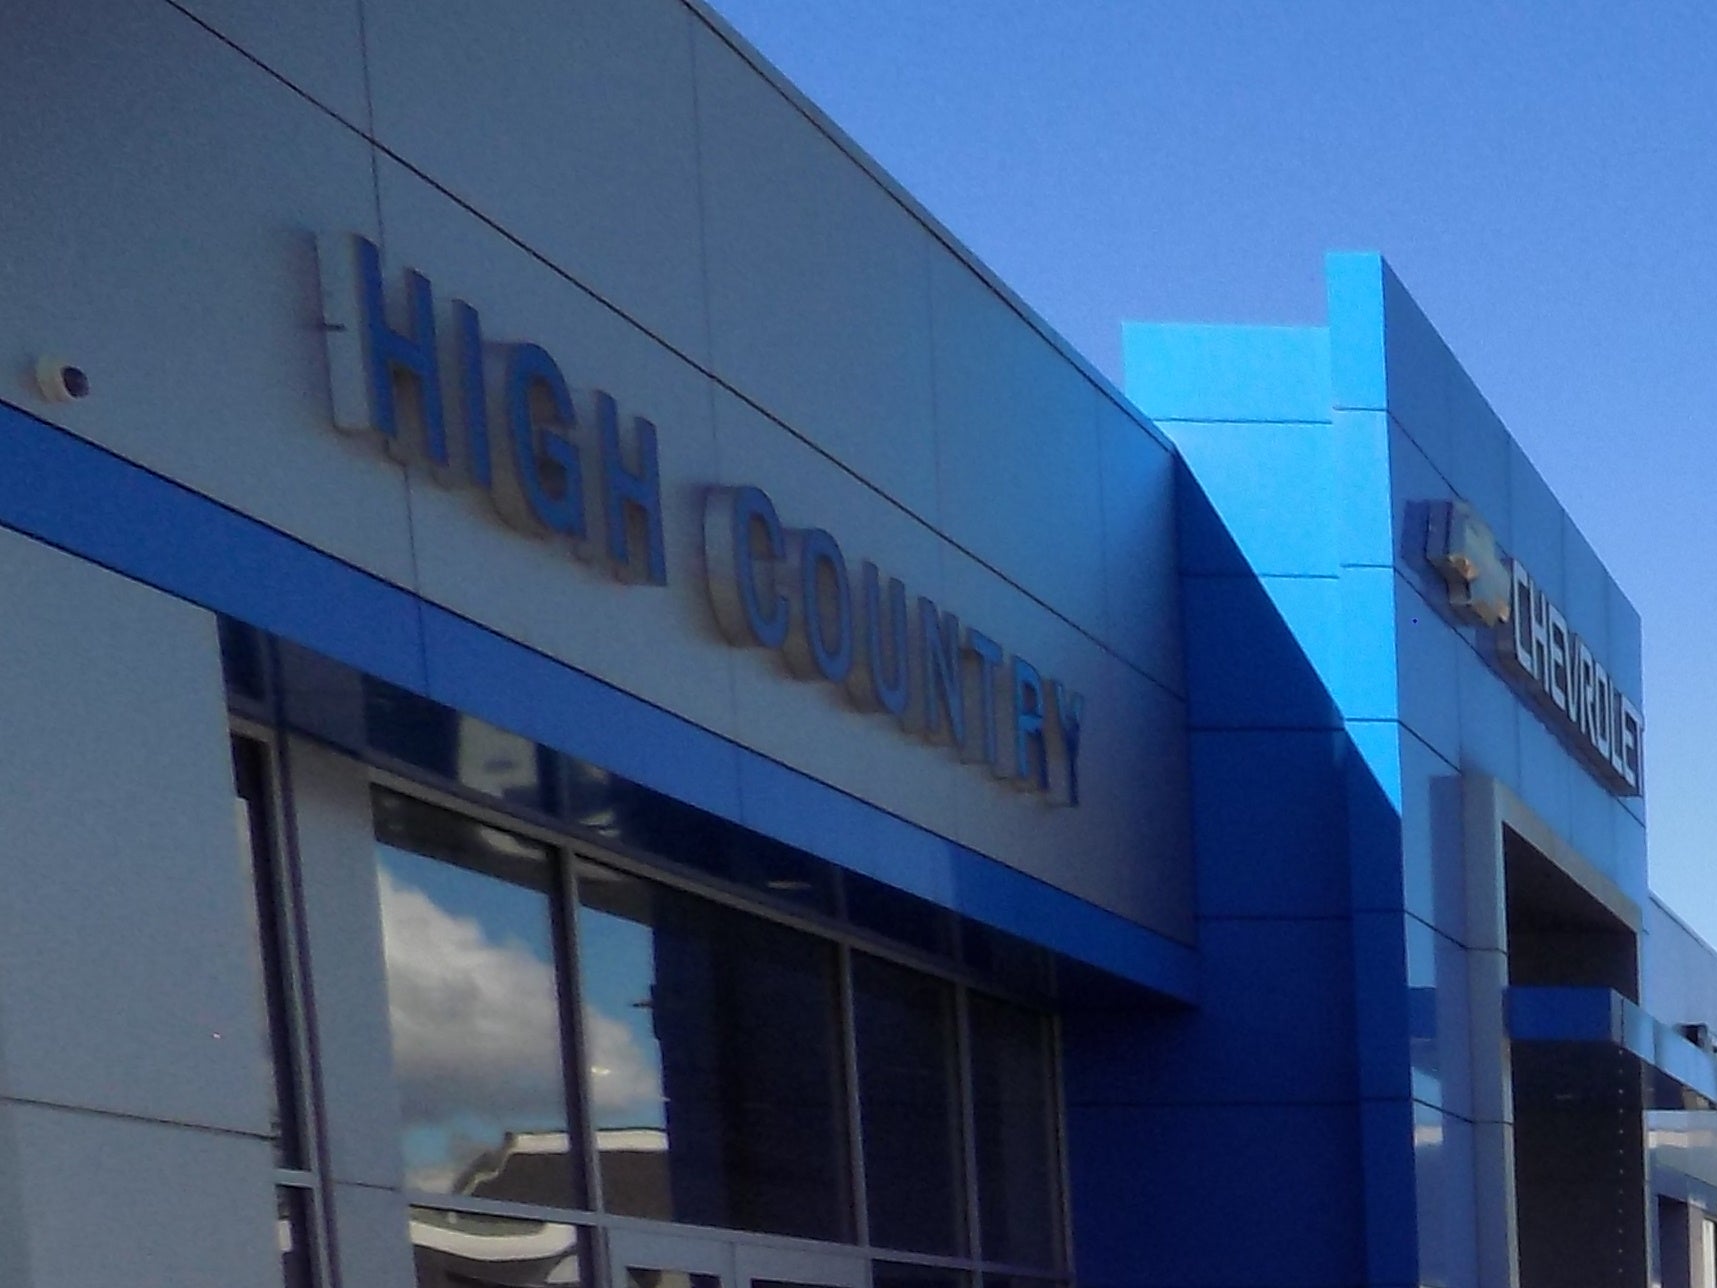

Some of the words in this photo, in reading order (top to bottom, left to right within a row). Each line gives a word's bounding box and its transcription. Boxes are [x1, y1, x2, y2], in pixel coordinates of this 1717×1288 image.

[338, 231, 667, 587] HIGH
[724, 482, 1086, 806] COUNTRY
[1510, 556, 1644, 798] CHEVROLET
